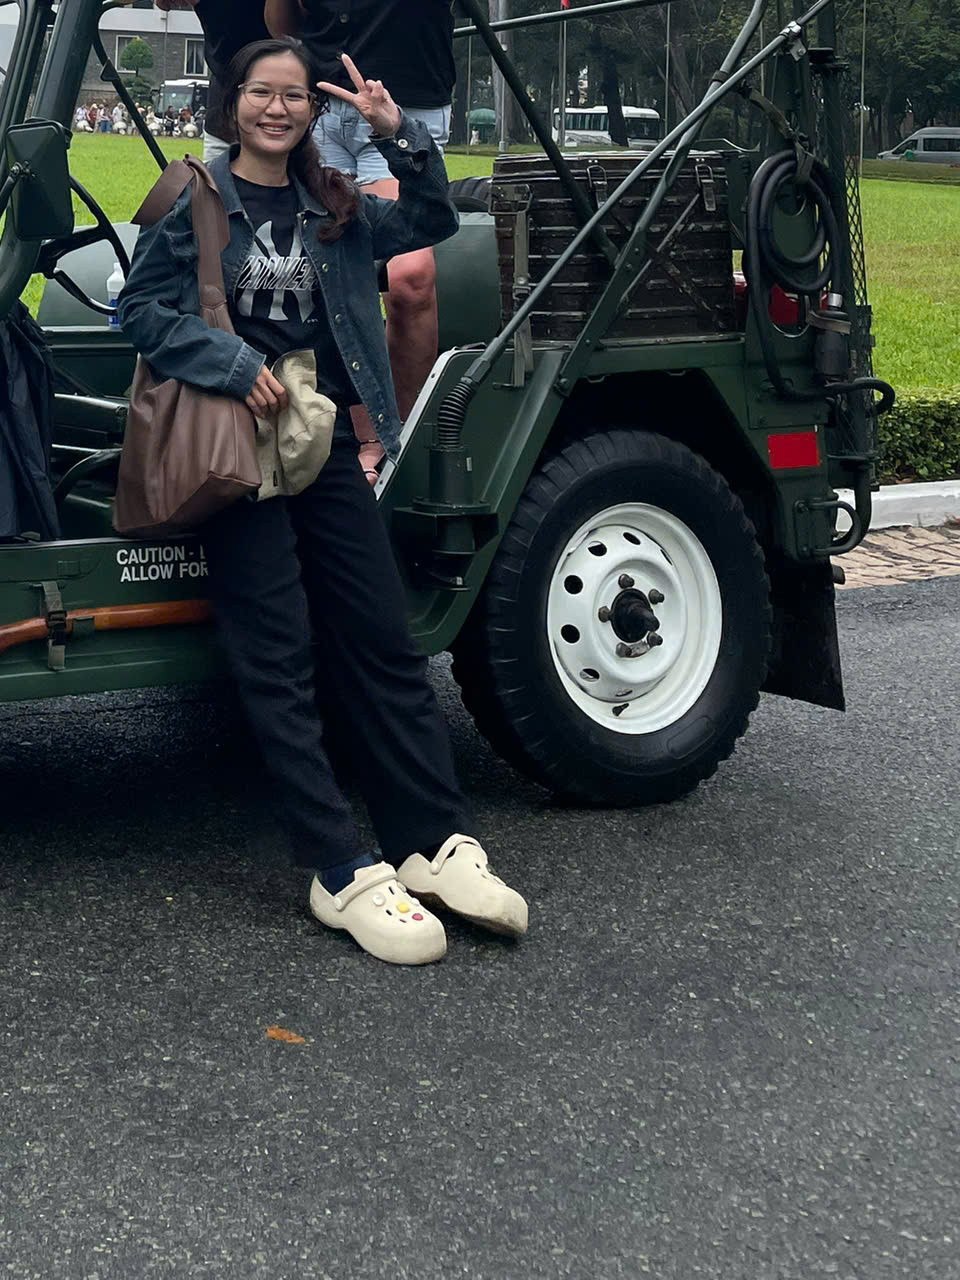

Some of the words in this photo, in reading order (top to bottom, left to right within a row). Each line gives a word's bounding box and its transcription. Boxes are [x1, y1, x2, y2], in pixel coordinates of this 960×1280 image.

[116, 545, 185, 565] CAUTION
[120, 563, 174, 583] ALLOW
[179, 562, 209, 578] FOR
